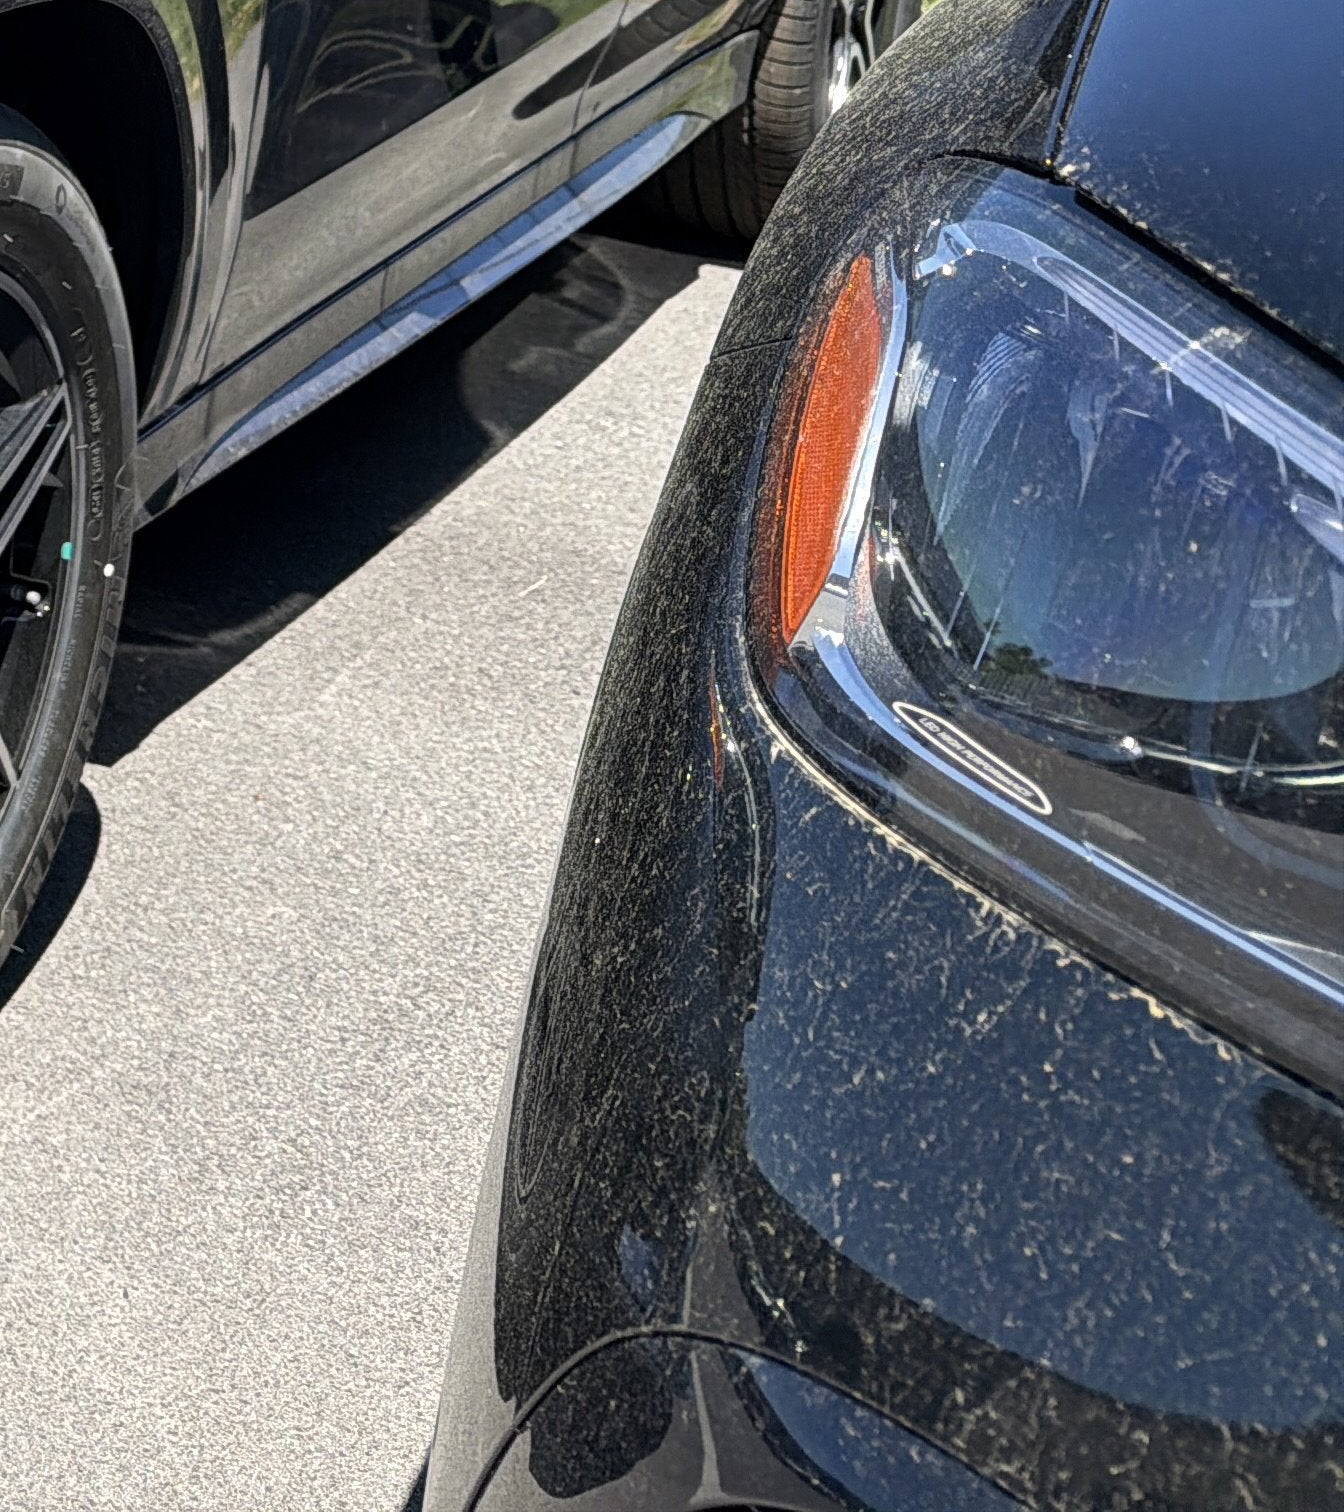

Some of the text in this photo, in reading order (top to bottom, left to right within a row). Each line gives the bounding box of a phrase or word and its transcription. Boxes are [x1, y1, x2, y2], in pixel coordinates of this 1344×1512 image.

[918, 717, 1034, 798] LED HIGH PERFORMANCE
